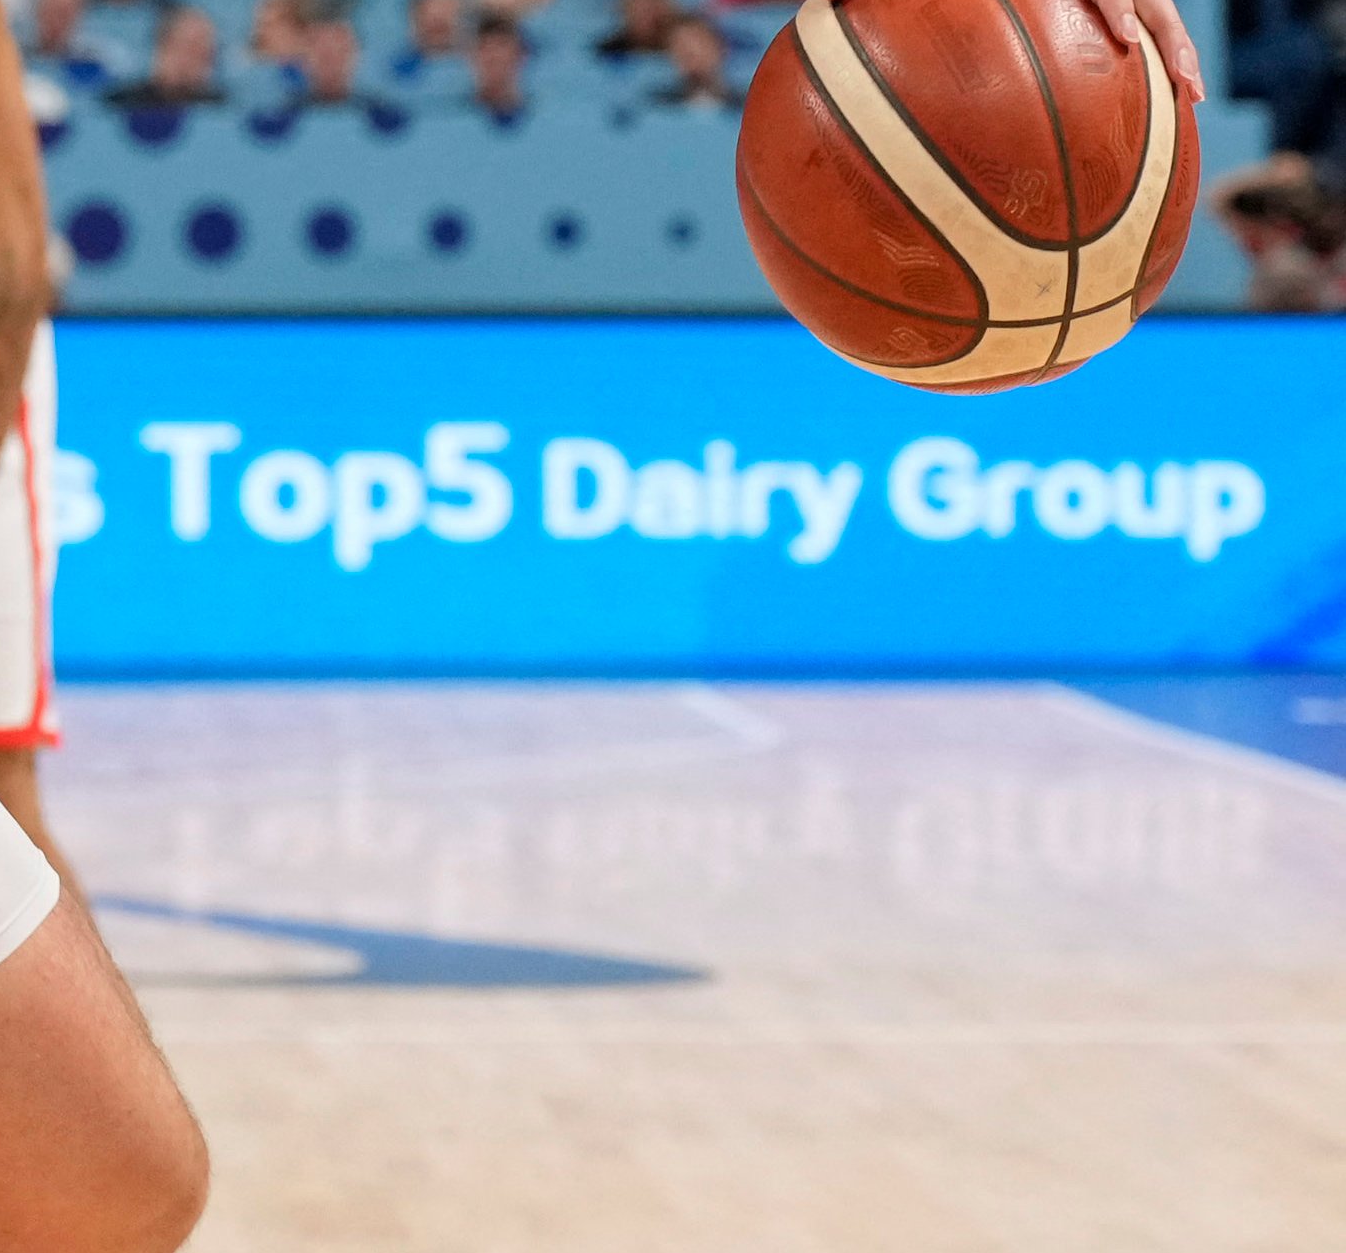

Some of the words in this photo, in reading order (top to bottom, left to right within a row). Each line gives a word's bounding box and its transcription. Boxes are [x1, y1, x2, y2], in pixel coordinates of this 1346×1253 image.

[138, 420, 515, 573] Top5
[541, 436, 864, 565] Dairy
[886, 435, 1267, 563] Group
